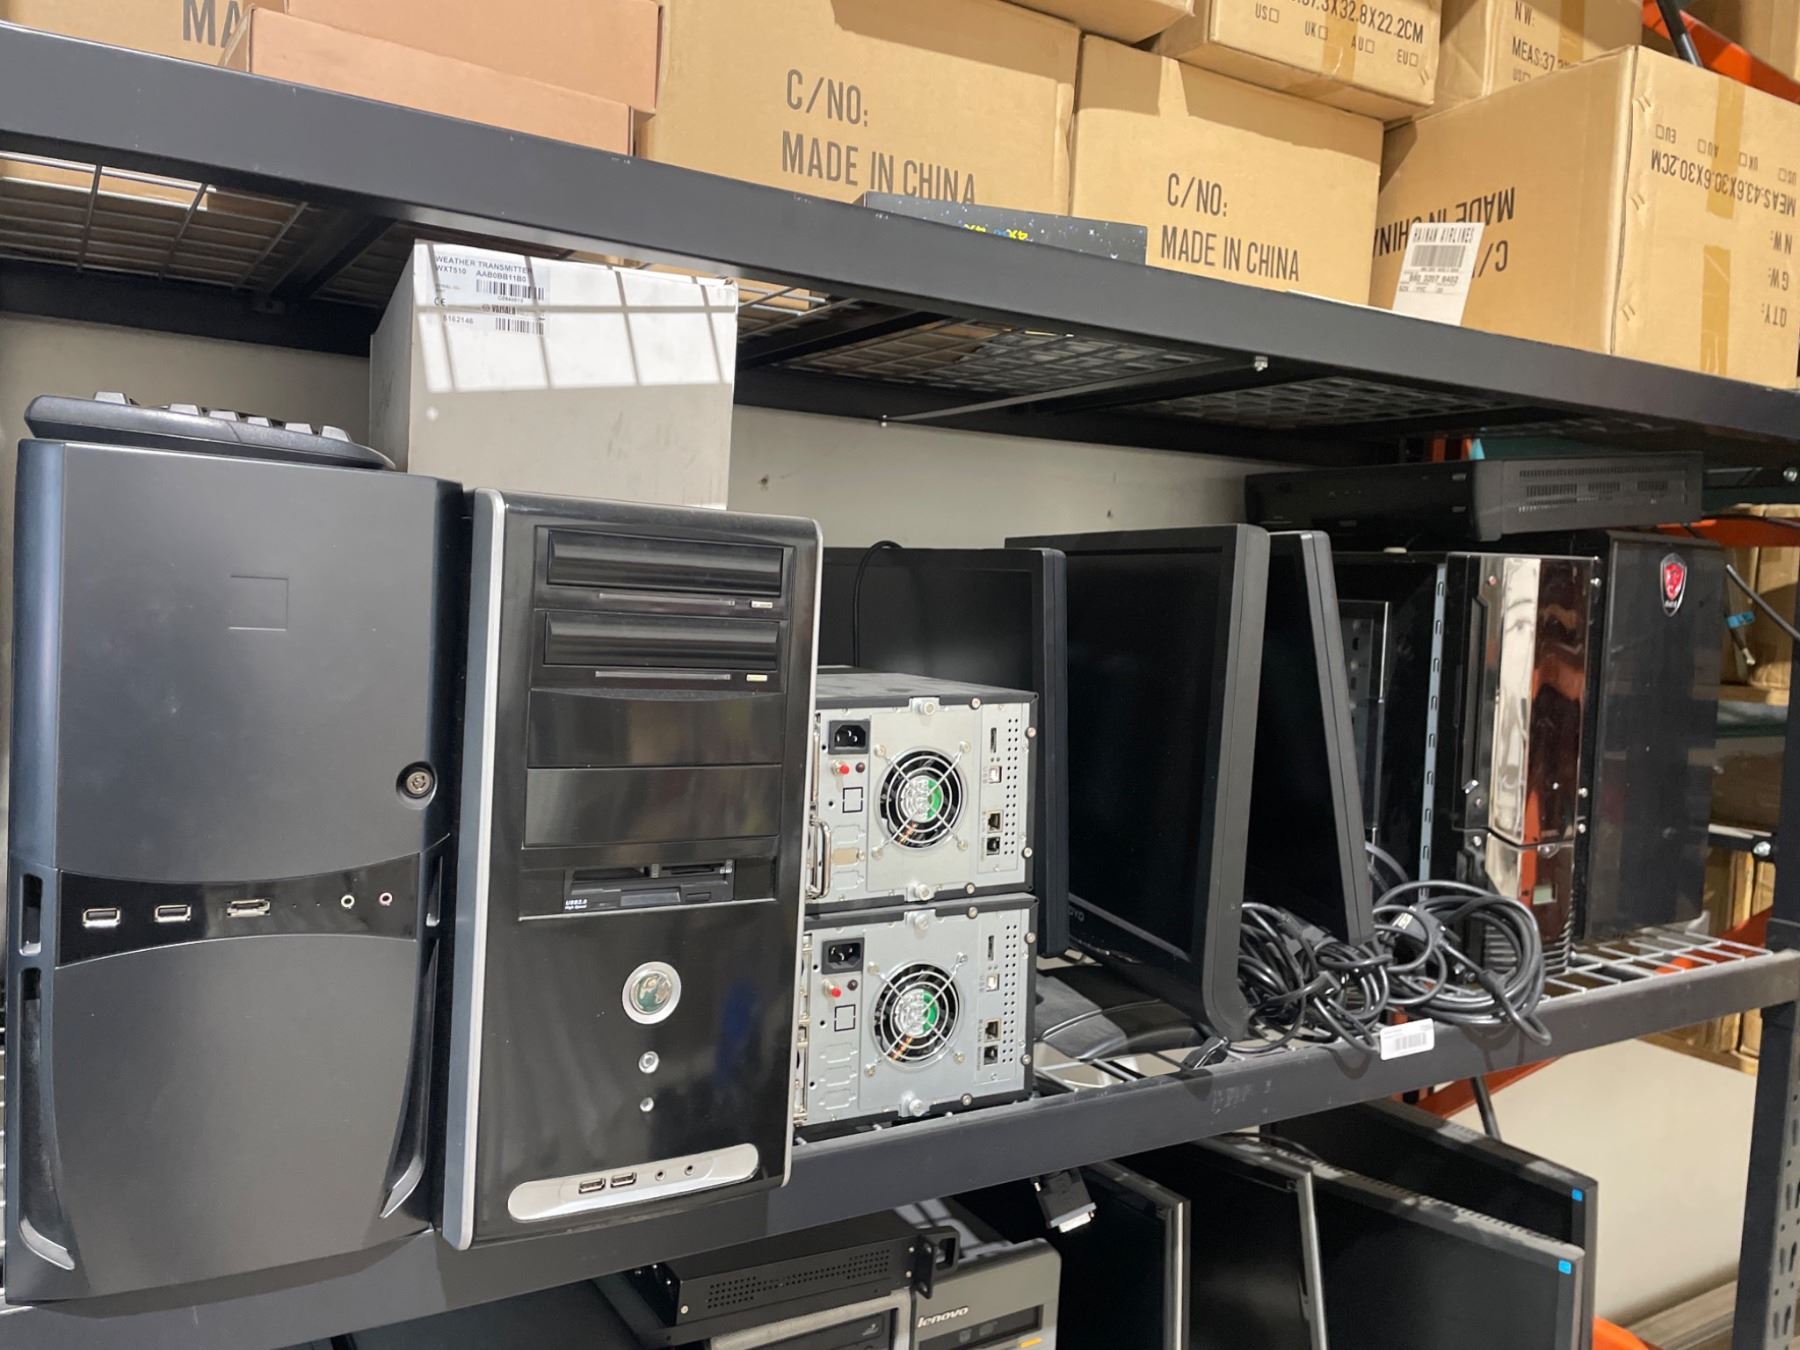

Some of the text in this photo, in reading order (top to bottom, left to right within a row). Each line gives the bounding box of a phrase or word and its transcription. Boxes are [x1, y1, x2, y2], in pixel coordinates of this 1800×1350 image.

[1397, 49, 1409, 65] EU
[786, 68, 868, 127] C/NO:
[782, 130, 975, 205] MADE IN CHINA
[1167, 172, 1227, 217] C/NO:
[437, 255, 533, 275] WEATHER TRANSMITTER
[1161, 224, 1299, 282] MADE IN CHINA
[436, 264, 467, 275] WXT510
[1761, 303, 1787, 328] QTY:
[918, 1307, 969, 1328] lenovo
